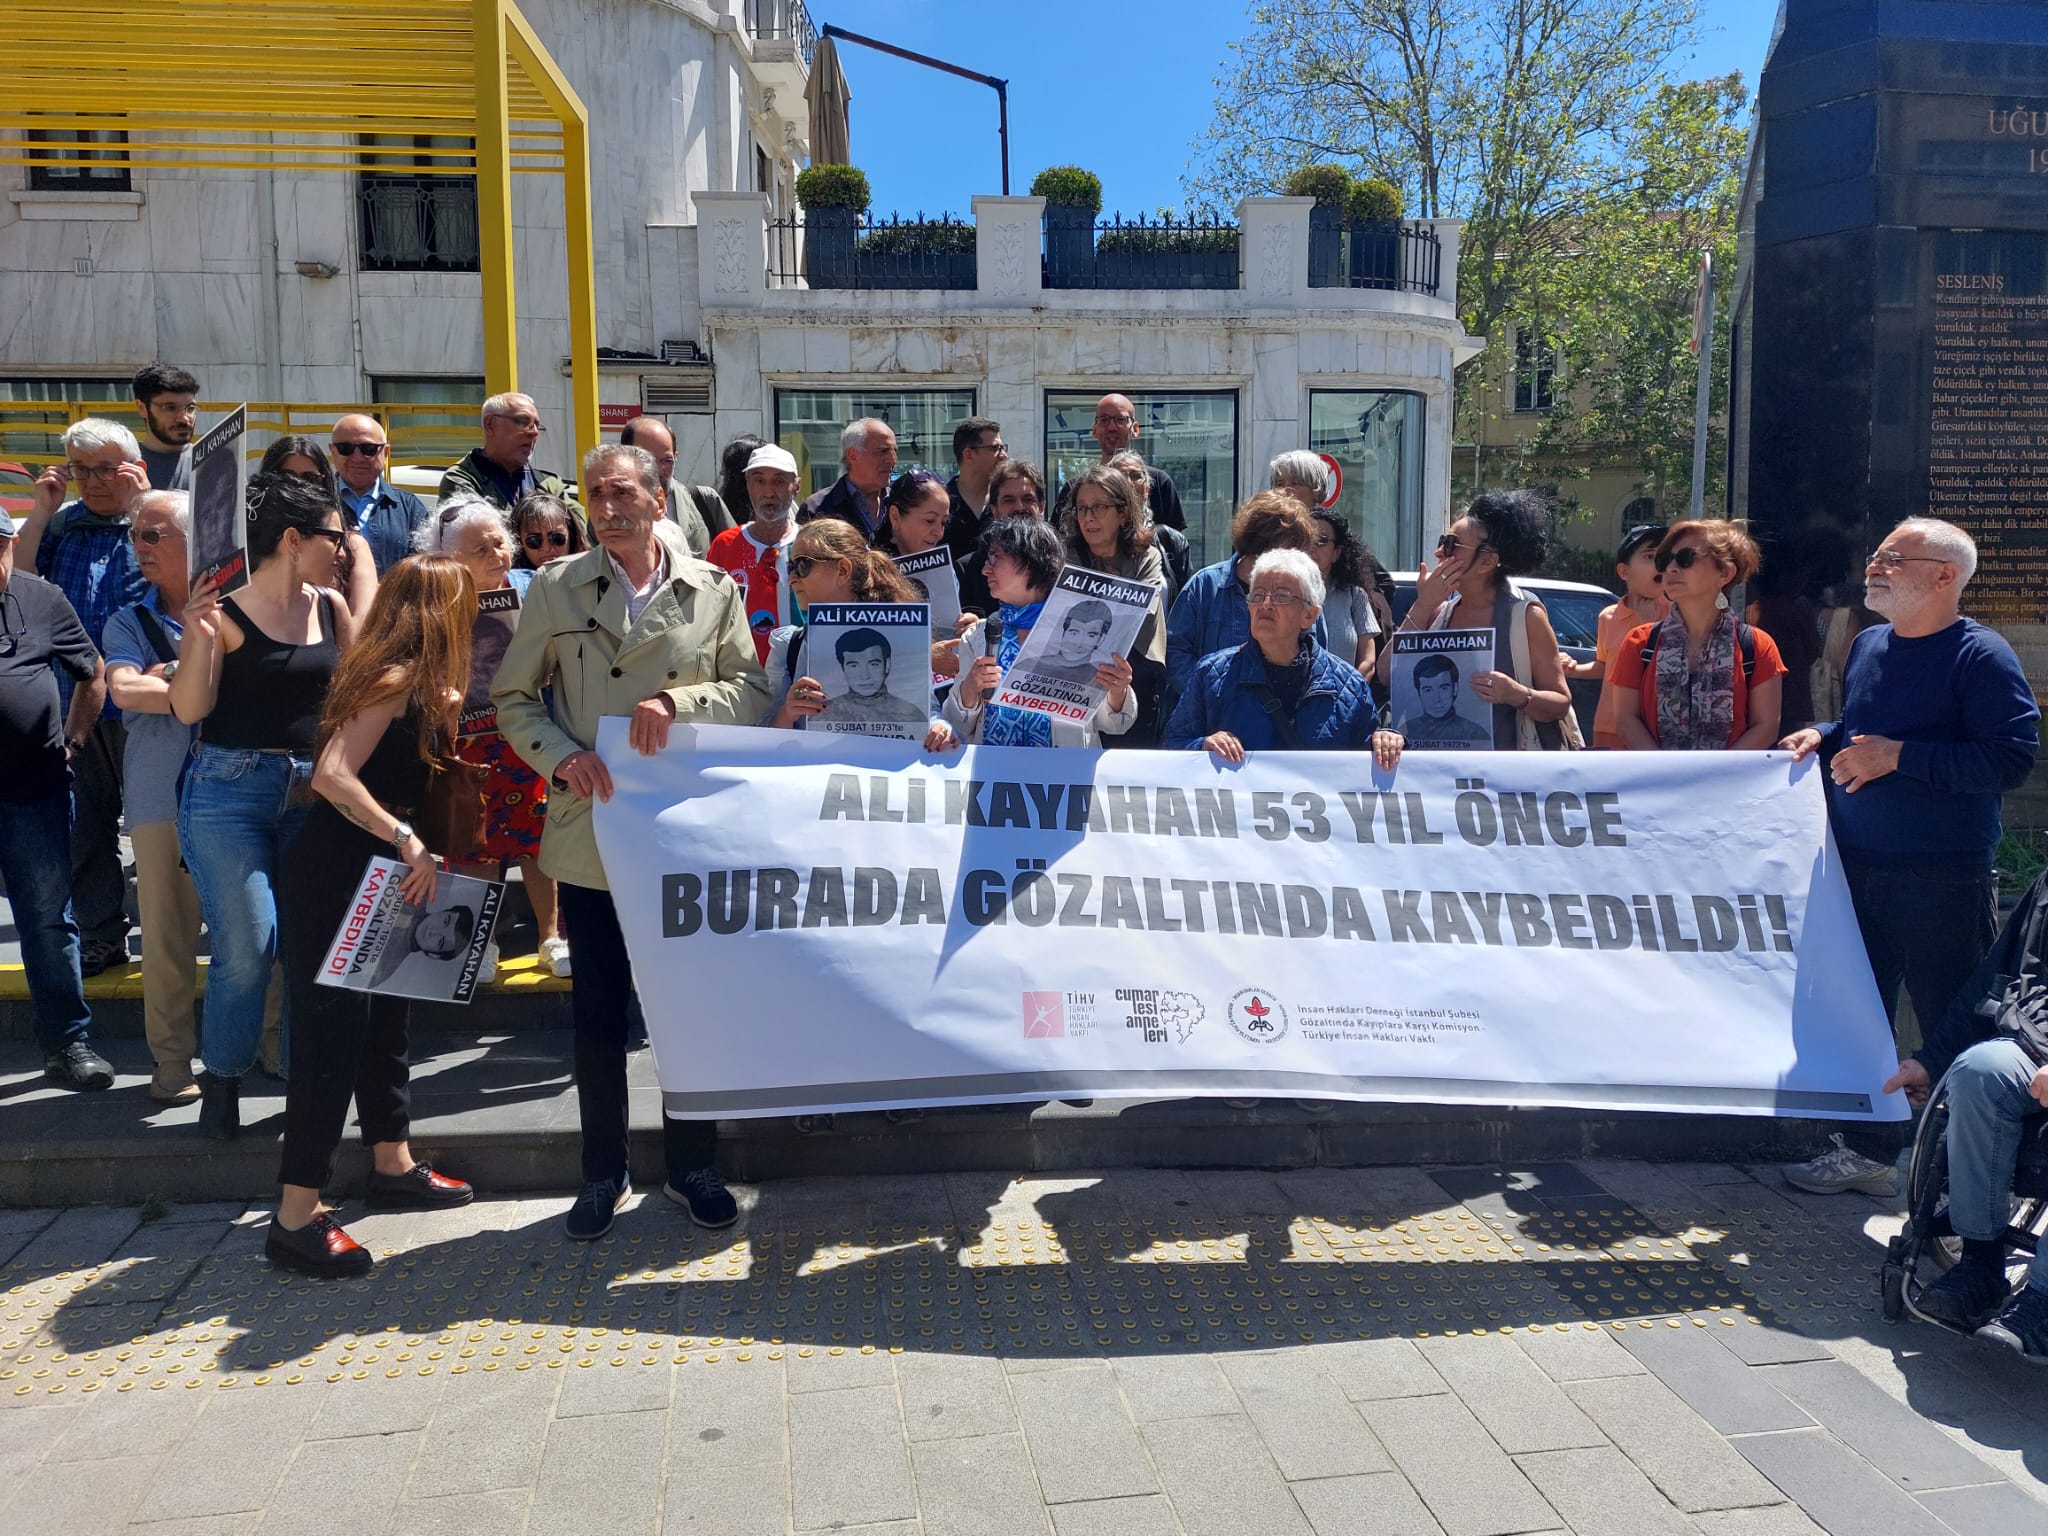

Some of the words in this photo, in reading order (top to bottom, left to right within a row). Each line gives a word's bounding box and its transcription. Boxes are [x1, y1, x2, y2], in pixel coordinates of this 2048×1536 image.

[1987, 104, 2048, 136] UĞU
[1937, 273, 2004, 292] SESLENİŞ
[600, 408, 629, 417] SHANE
[207, 417, 241, 451] KAYAHAN
[900, 553, 945, 574] AYAHAN
[1063, 574, 1088, 591] ALİ
[1088, 580, 1149, 604] KAYAHAN
[815, 608, 840, 622] ALİ
[845, 610, 922, 623] KAYAHAN
[1398, 636, 1418, 650] ALİ
[1422, 636, 1487, 650] KAYAHAN
[1000, 692, 1088, 720] KAYBEDİLDİ
[1010, 679, 1090, 707] GÖZALTINDA
[826, 723, 833, 731] 6
[870, 723, 904, 731] 1973'te
[944, 779, 1240, 838] KAYAHAN
[1253, 791, 1331, 843] 53
[1335, 791, 1444, 845] YIL
[1454, 778, 1627, 848] ÖNCE
[482, 888, 497, 916] ALİ
[661, 867, 947, 938] BURADA
[962, 858, 1376, 942] GÖZALTINDA
[328, 867, 387, 977] KAYBEDİLDİ
[348, 873, 401, 974] GÖZALTINDA
[457, 918, 491, 995] KAYAHAN
[1067, 990, 1095, 1004] TİHV
[1115, 989, 1159, 1001] cumar
[1300, 1018, 1355, 1027] Gözaltında
[1431, 1022, 1480, 1033] Komisyon
[1302, 1030, 1340, 1042] Türkiye
